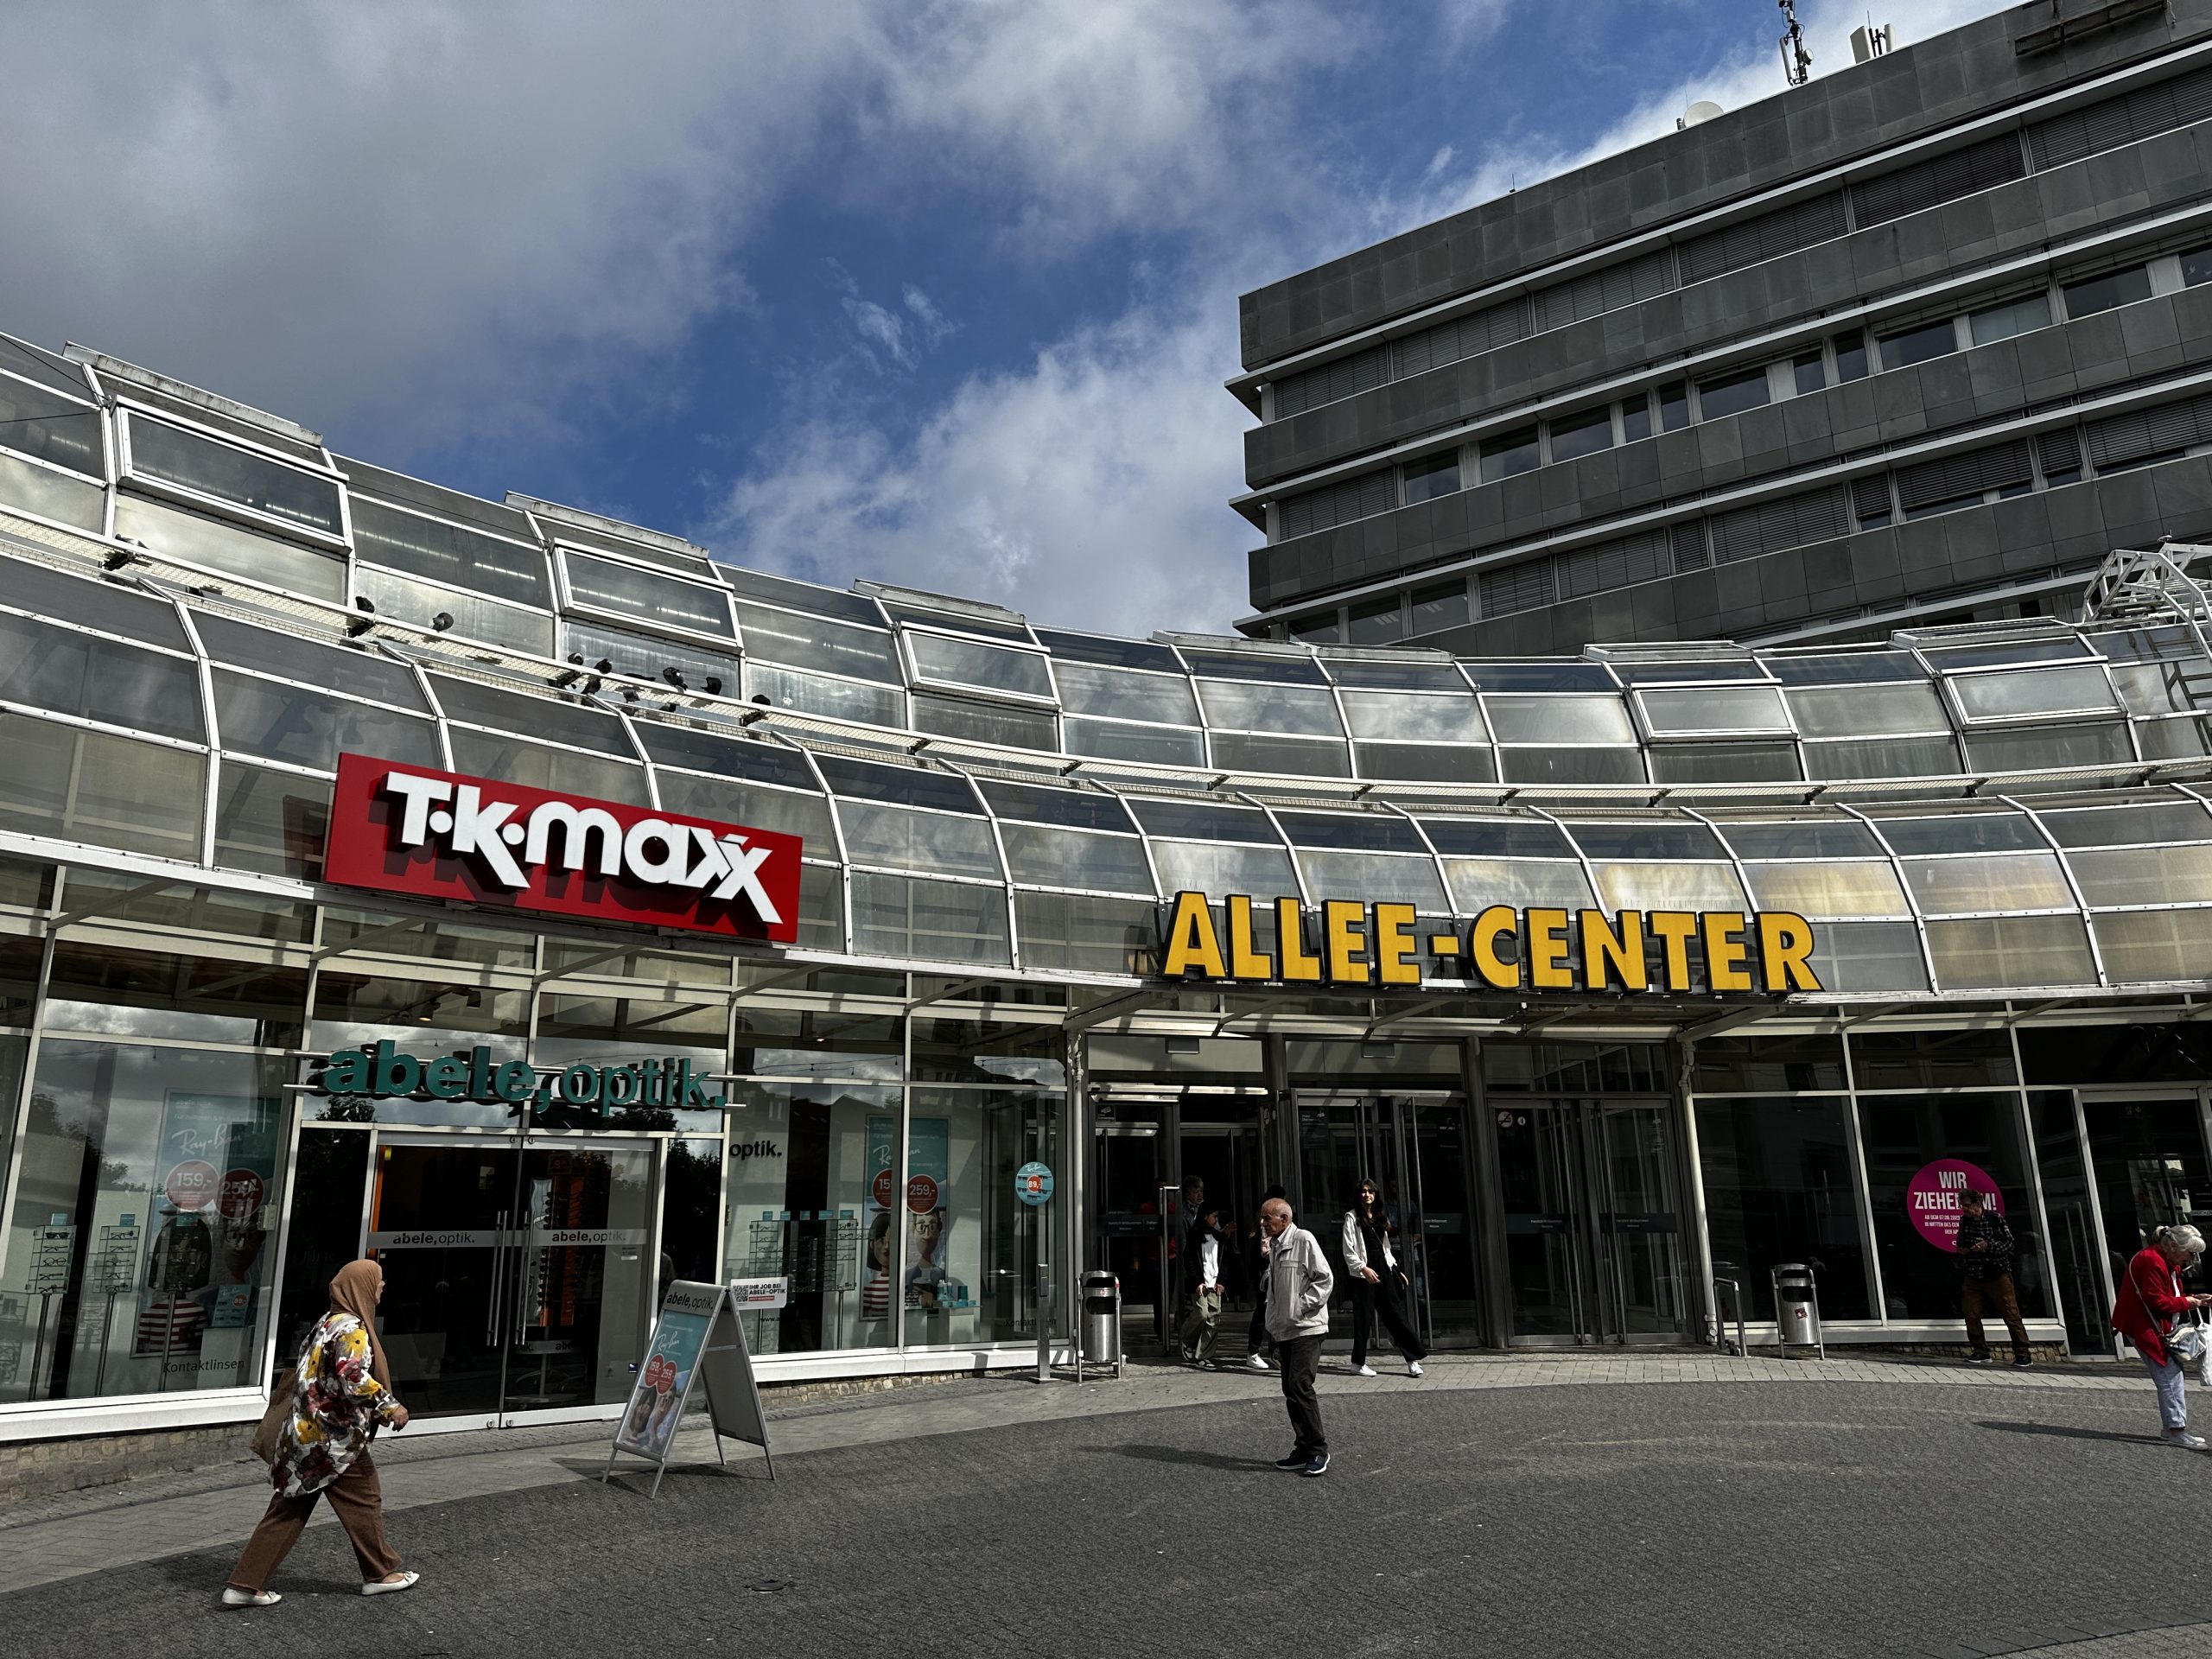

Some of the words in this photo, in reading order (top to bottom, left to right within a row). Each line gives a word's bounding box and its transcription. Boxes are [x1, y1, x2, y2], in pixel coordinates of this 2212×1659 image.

[1161, 890, 1826, 995] ALLEE-CENTER
[171, 1123, 243, 1156] Ray-Ban
[729, 1140, 782, 1160] optik.
[176, 1173, 213, 1190] 159,-
[878, 1179, 892, 1190] 15
[1938, 1171, 1967, 1189] WIR
[909, 1184, 936, 1197] 259,-
[1981, 1192, 1998, 1211] M!
[162, 1359, 245, 1373] Kontaktlinsen
